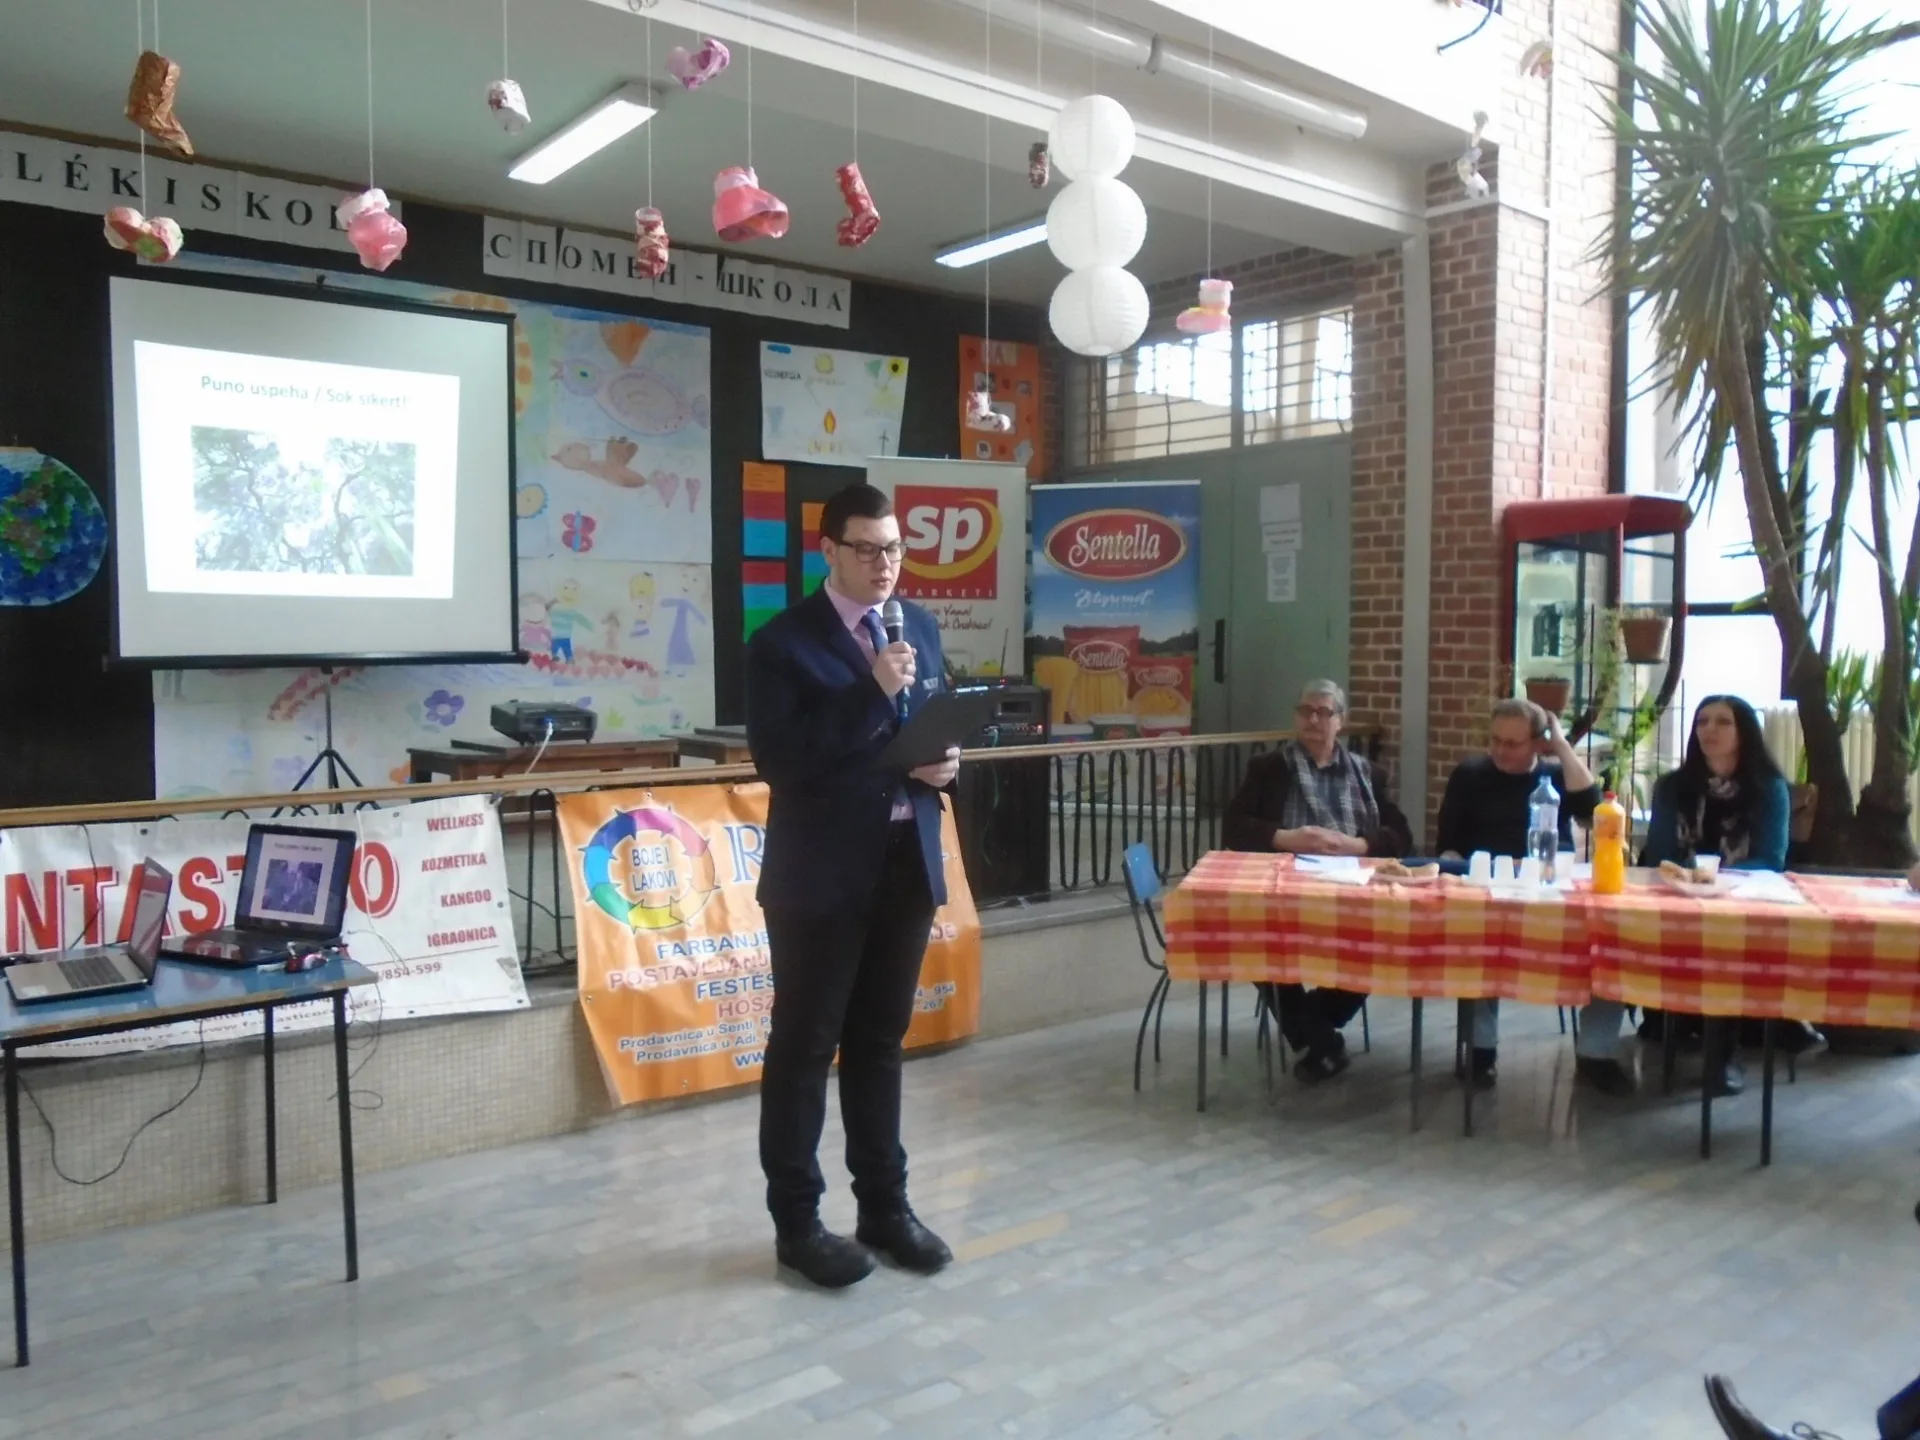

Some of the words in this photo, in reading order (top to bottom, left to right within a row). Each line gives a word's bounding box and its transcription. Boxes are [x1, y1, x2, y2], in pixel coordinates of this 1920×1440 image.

[0, 149, 350, 233] LÉKISKOL
[720, 269, 844, 313] ШКОЛА
[201, 375, 245, 393] Puno
[250, 384, 308, 400] uspeha
[327, 388, 353, 403] Sok
[359, 393, 407, 408] sikert!
[1068, 523, 1161, 567] Sentella
[426, 812, 485, 832] WELLNESS
[421, 852, 488, 872] KOZMETIKA
[632, 846, 663, 867] BOJE
[632, 869, 677, 892] LAKOVI
[440, 888, 492, 908] KANGOO
[427, 926, 497, 947] IGRAONICA
[377, 961, 442, 981] /854-599
[609, 953, 769, 989] POSTAVLJANJ
[718, 995, 773, 1018] HOSZ
[620, 1029, 703, 1049] Prodavnica
[636, 1042, 717, 1062] Prodavnica
[721, 1040, 730, 1048] u
